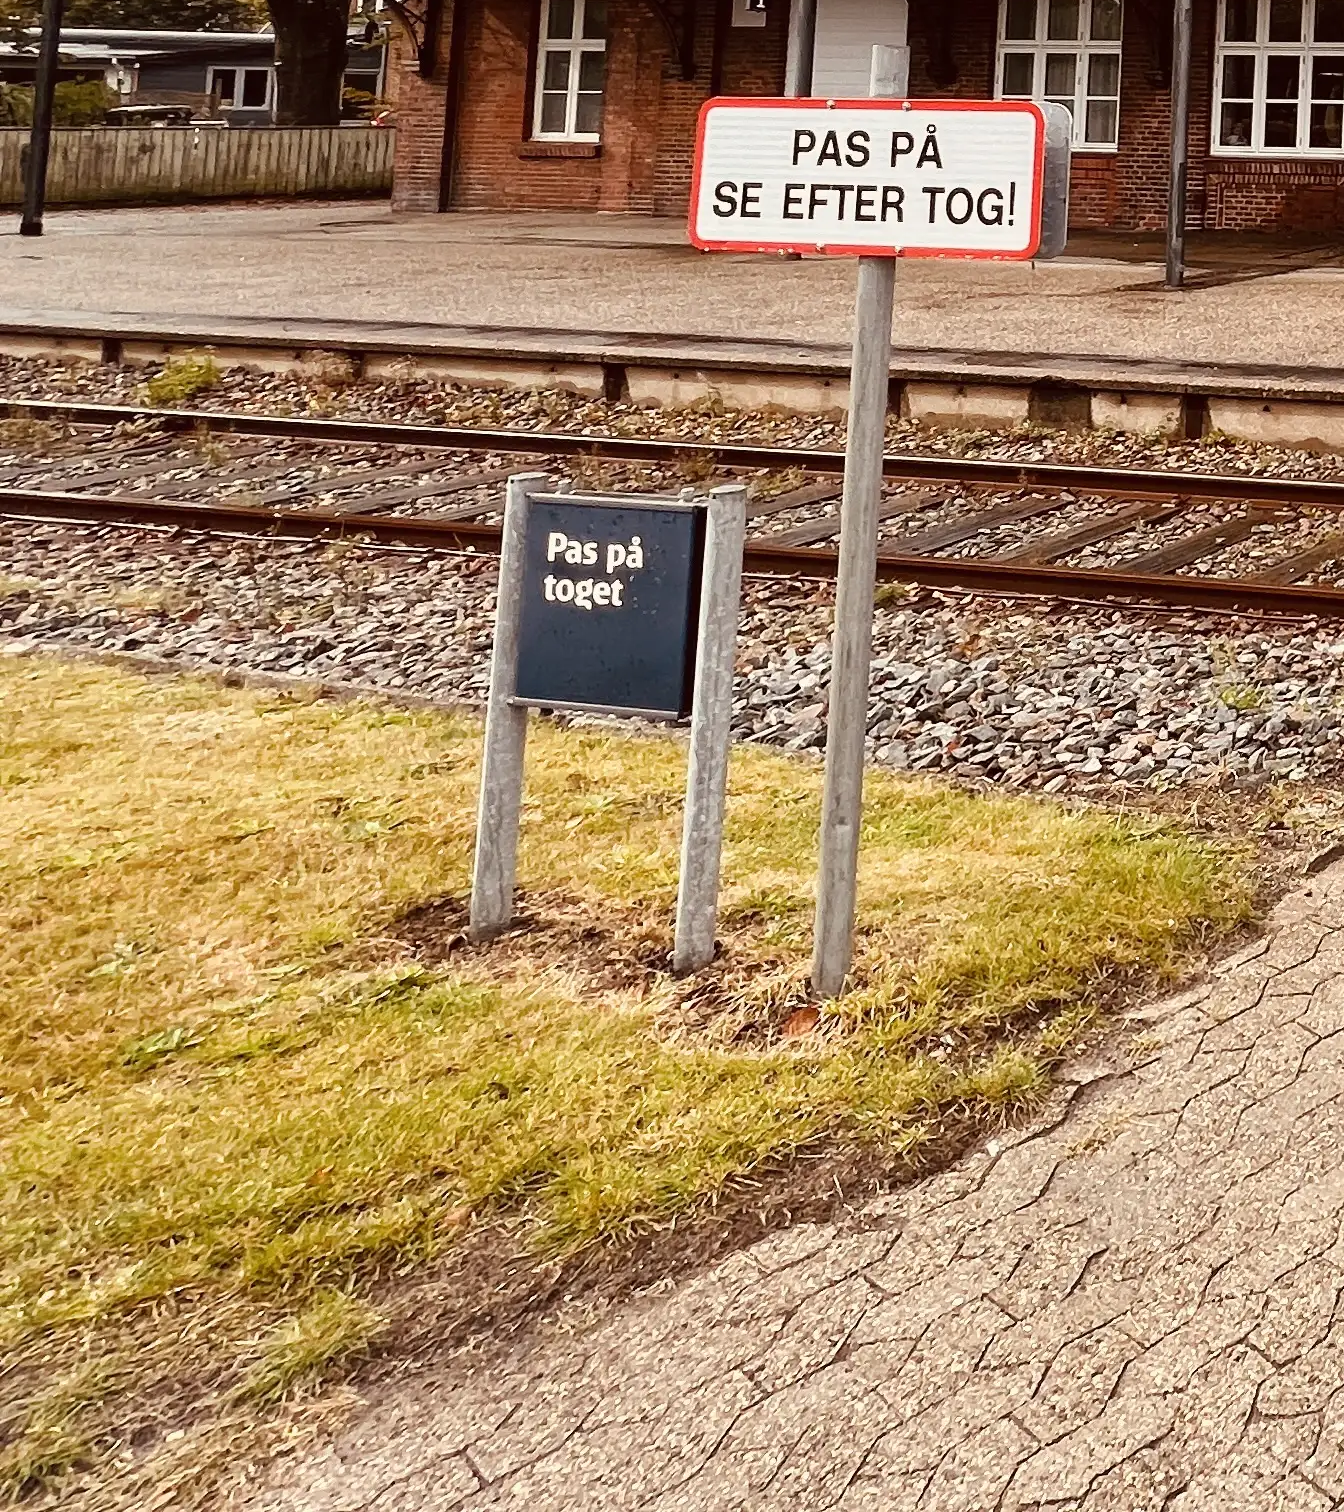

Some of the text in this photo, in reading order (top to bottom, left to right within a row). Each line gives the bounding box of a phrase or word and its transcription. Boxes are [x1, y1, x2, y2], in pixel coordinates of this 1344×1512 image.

[792, 123, 943, 169] PAS PÅ
[712, 180, 1017, 227] SE EFTER TOG!
[546, 531, 645, 574] Pas på
[543, 573, 625, 611] toget
